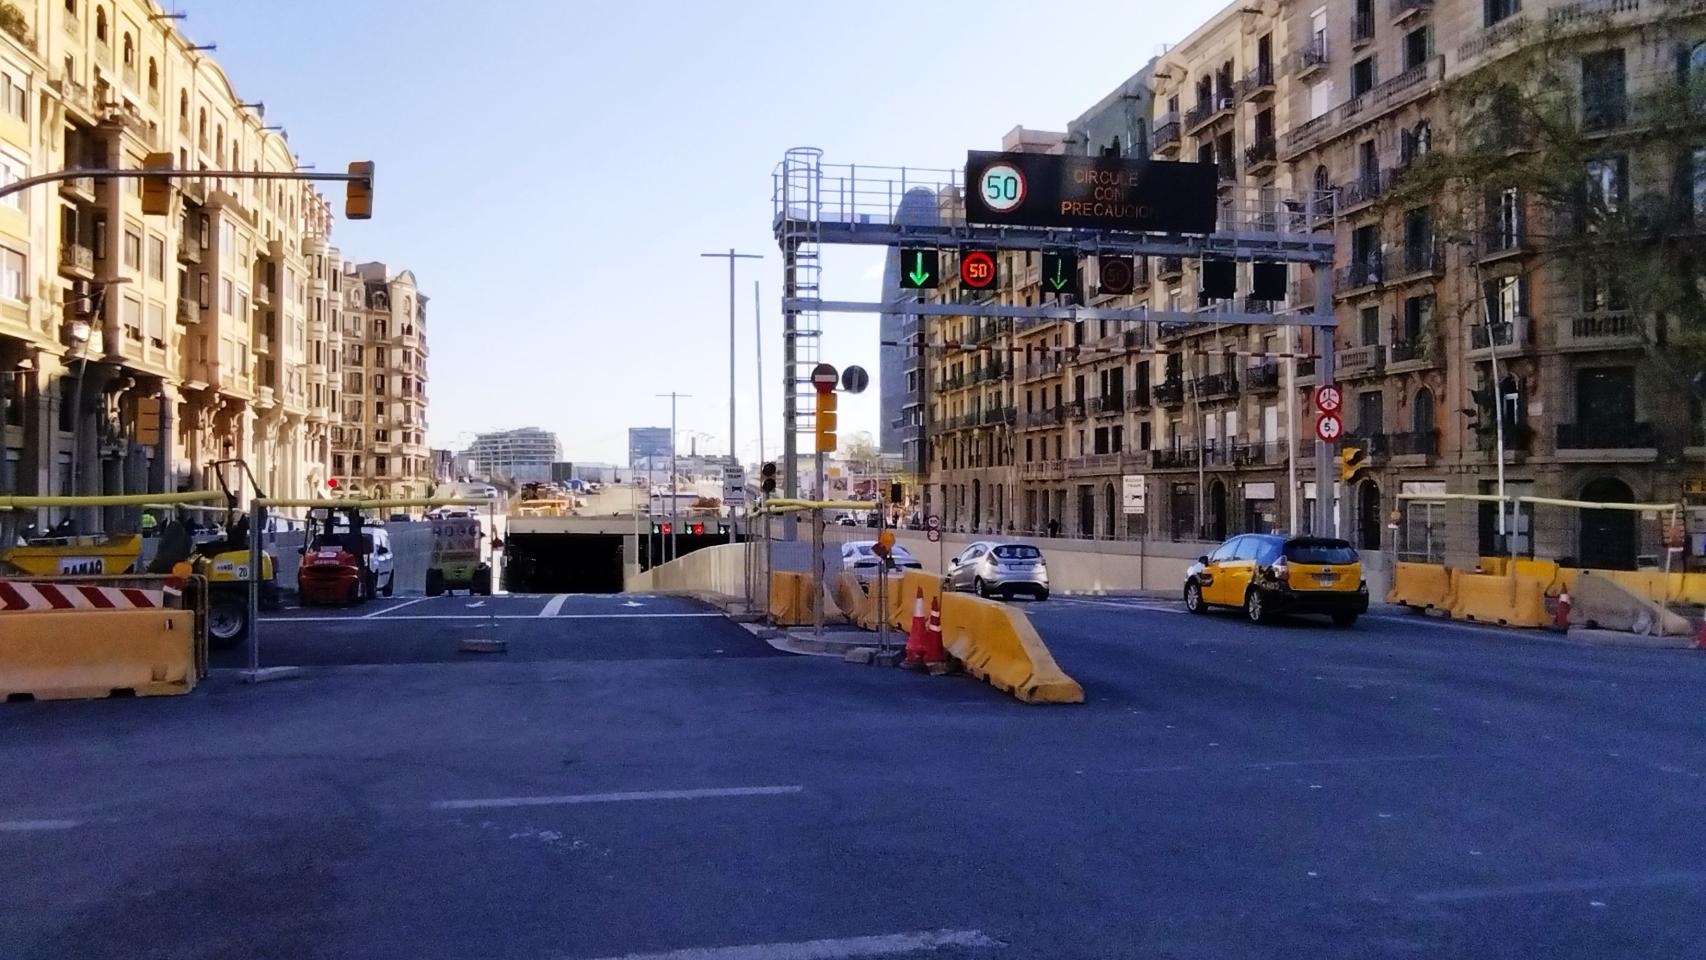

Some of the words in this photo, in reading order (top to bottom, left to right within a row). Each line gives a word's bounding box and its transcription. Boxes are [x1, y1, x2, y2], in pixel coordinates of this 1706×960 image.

[1073, 168, 1138, 187] CIRCUE
[987, 175, 1018, 200] 50
[1061, 201, 1152, 218] PRECAUCIO
[969, 263, 987, 278] 50
